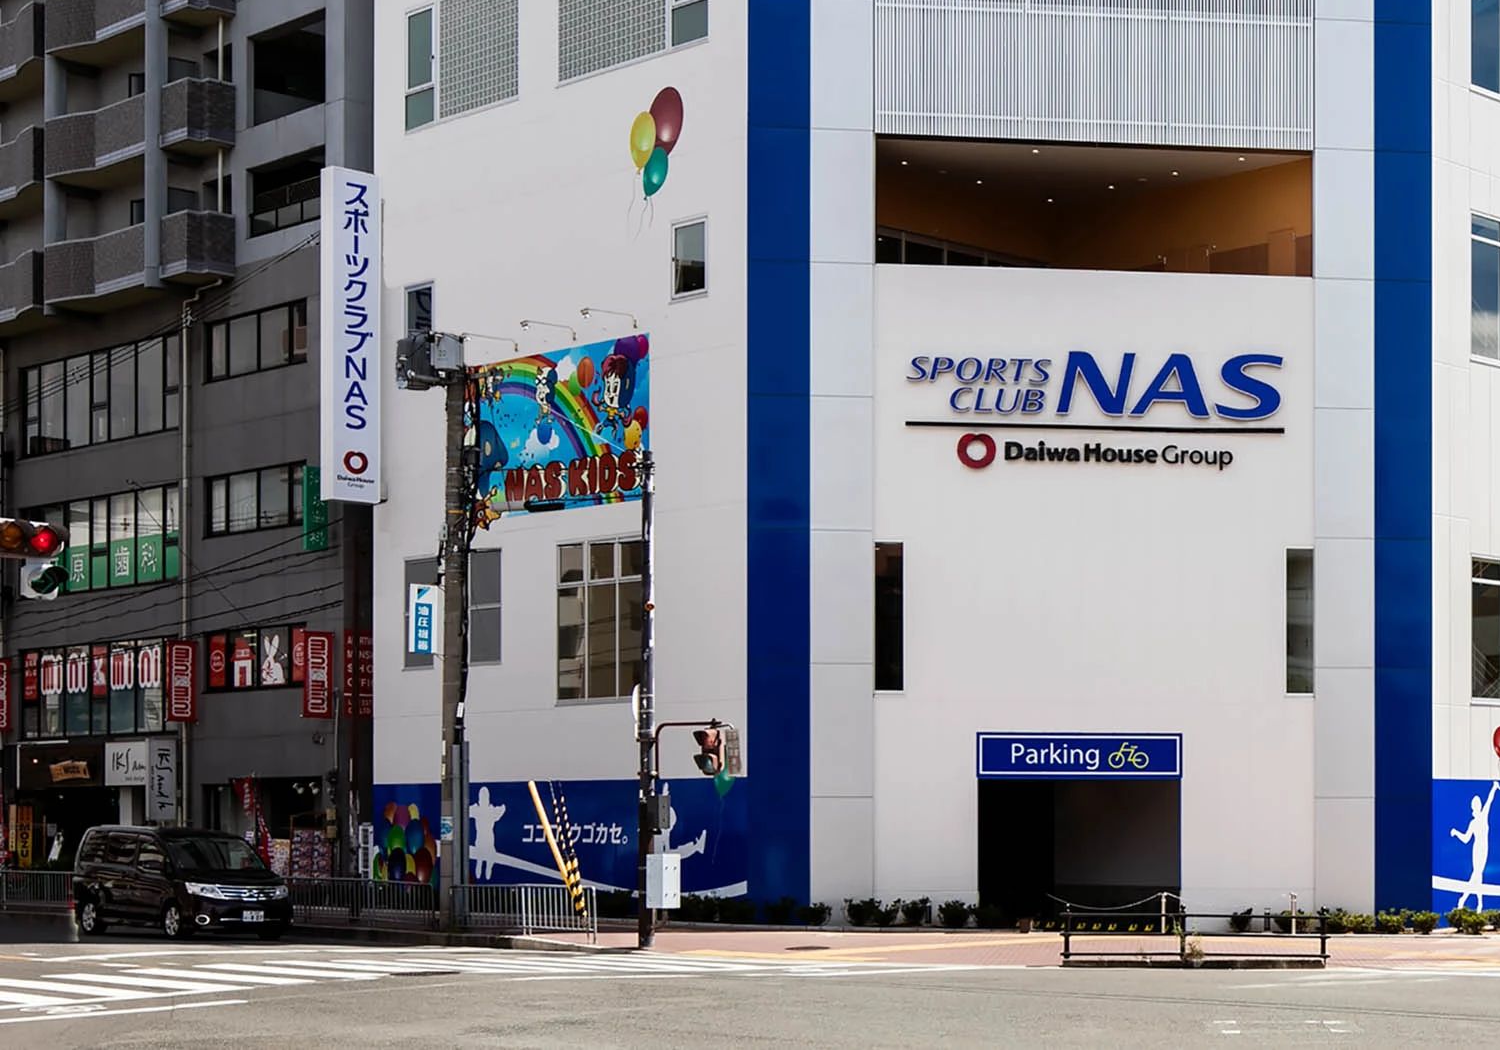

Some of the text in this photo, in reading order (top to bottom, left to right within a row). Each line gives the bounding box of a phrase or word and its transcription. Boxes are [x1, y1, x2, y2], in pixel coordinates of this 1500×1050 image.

[343, 181, 373, 430] スポーツクラブNAS
[906, 355, 1051, 384] SPORTS
[949, 386, 1046, 415] CLUB
[1055, 350, 1285, 421] NAS
[1004, 440, 1234, 470] Daiwa House Group
[505, 449, 641, 502] NAS KIDS
[51, 542, 158, 583] 原歯科
[1010, 742, 1101, 771] Parking
[522, 822, 629, 846] ココウゴカセ。
